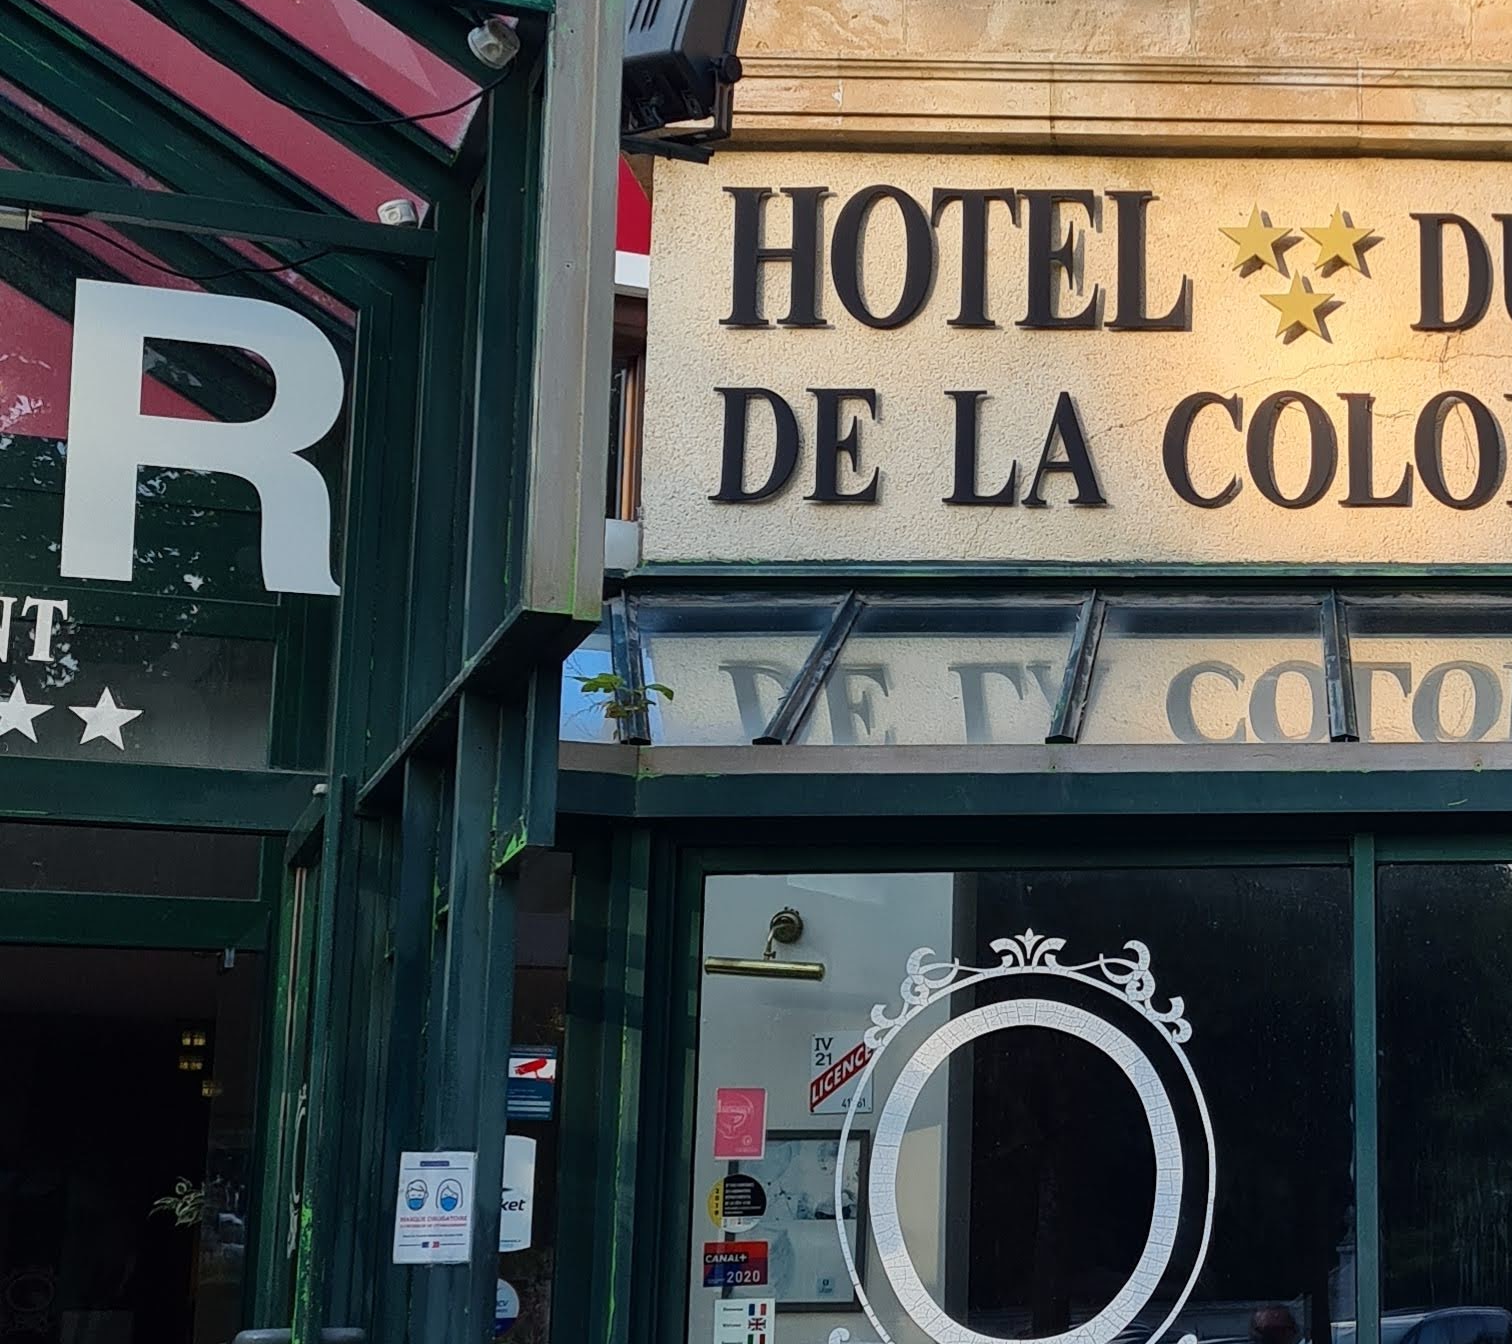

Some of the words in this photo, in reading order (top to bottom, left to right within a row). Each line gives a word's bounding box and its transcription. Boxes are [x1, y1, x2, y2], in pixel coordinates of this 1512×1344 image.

[718, 184, 1189, 333] HOTEL
[707, 386, 882, 507] DE
[941, 389, 1108, 509] LA
[815, 1037, 834, 1051] IV
[815, 1053, 832, 1066] 21
[811, 1045, 873, 1105] LICENCE
[841, 1097, 866, 1107] 4161
[705, 1254, 747, 1263] CANAL+
[726, 1271, 760, 1283] 2020
